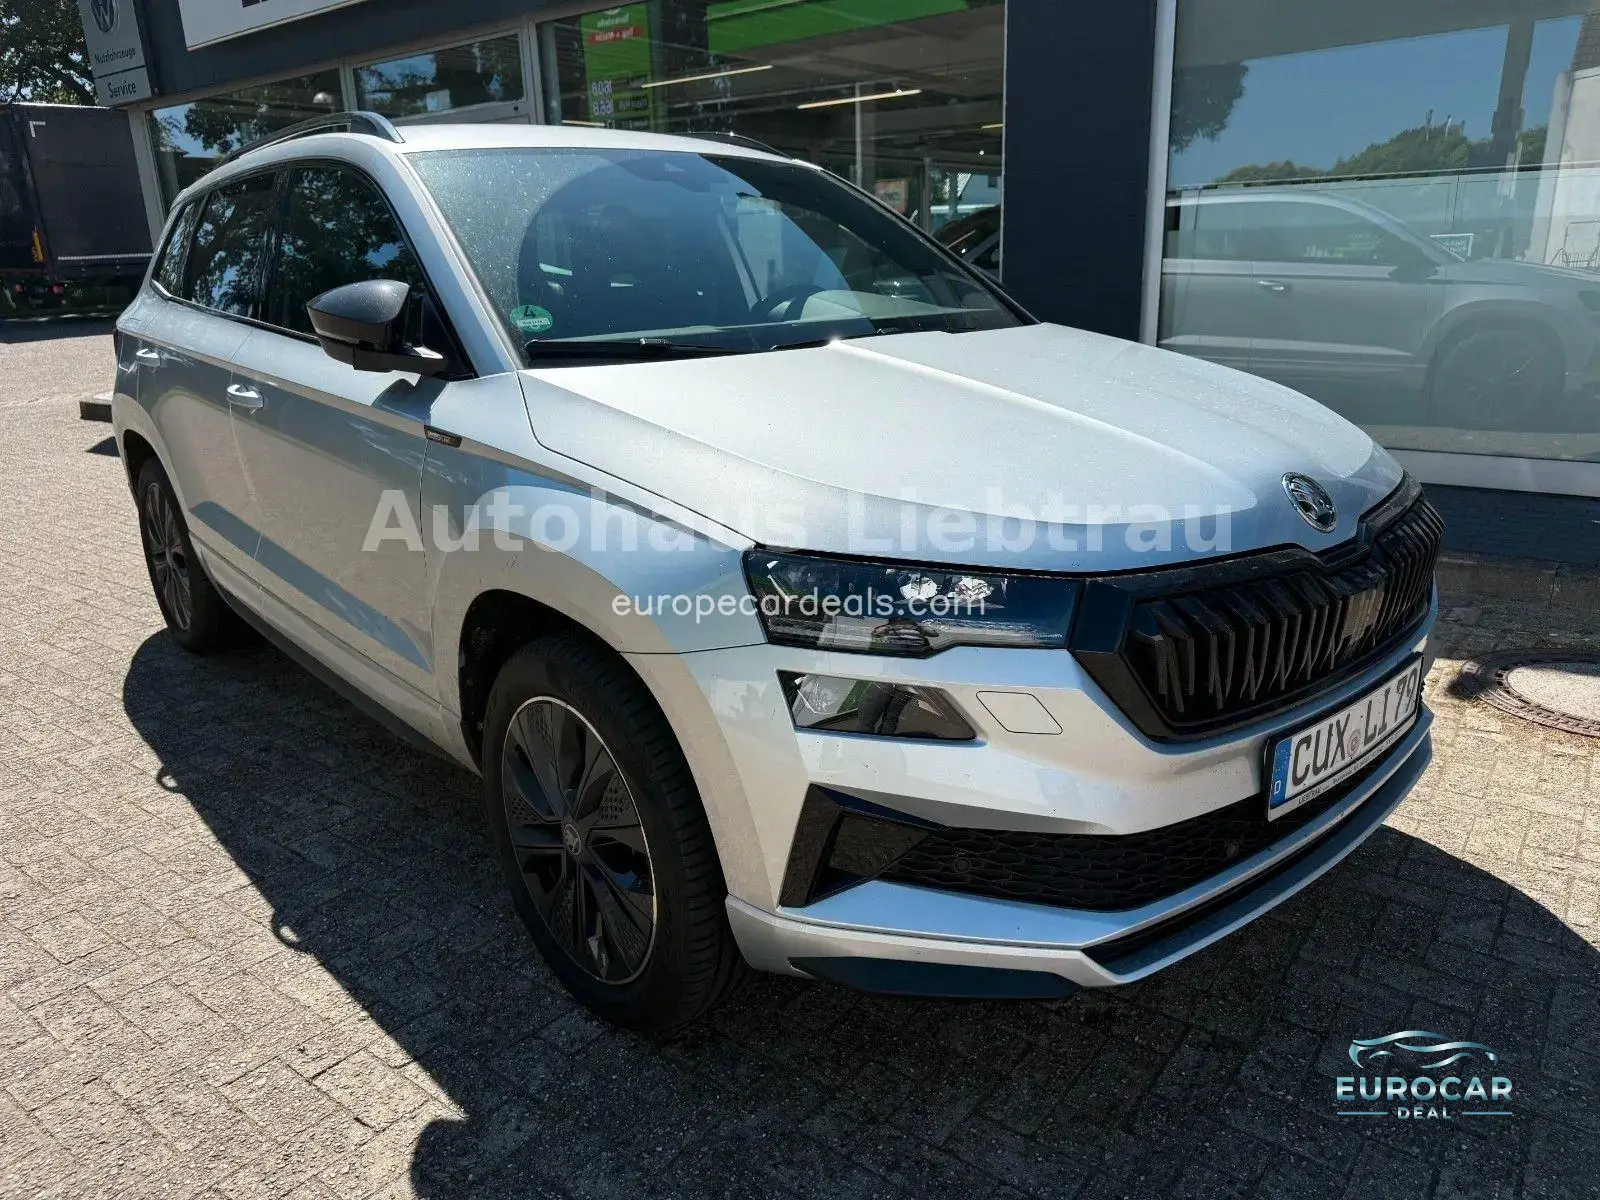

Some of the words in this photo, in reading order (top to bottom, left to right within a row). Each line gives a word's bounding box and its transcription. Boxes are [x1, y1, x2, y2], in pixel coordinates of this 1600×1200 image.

[95, 47, 136, 64] Nutzfahrzeuge
[108, 80, 136, 98] Service
[523, 305, 537, 318] 4
[1292, 714, 1350, 787] CUX
[1364, 688, 1391, 746] LI
[1395, 669, 1418, 723] 79
[1274, 780, 1281, 795] D
